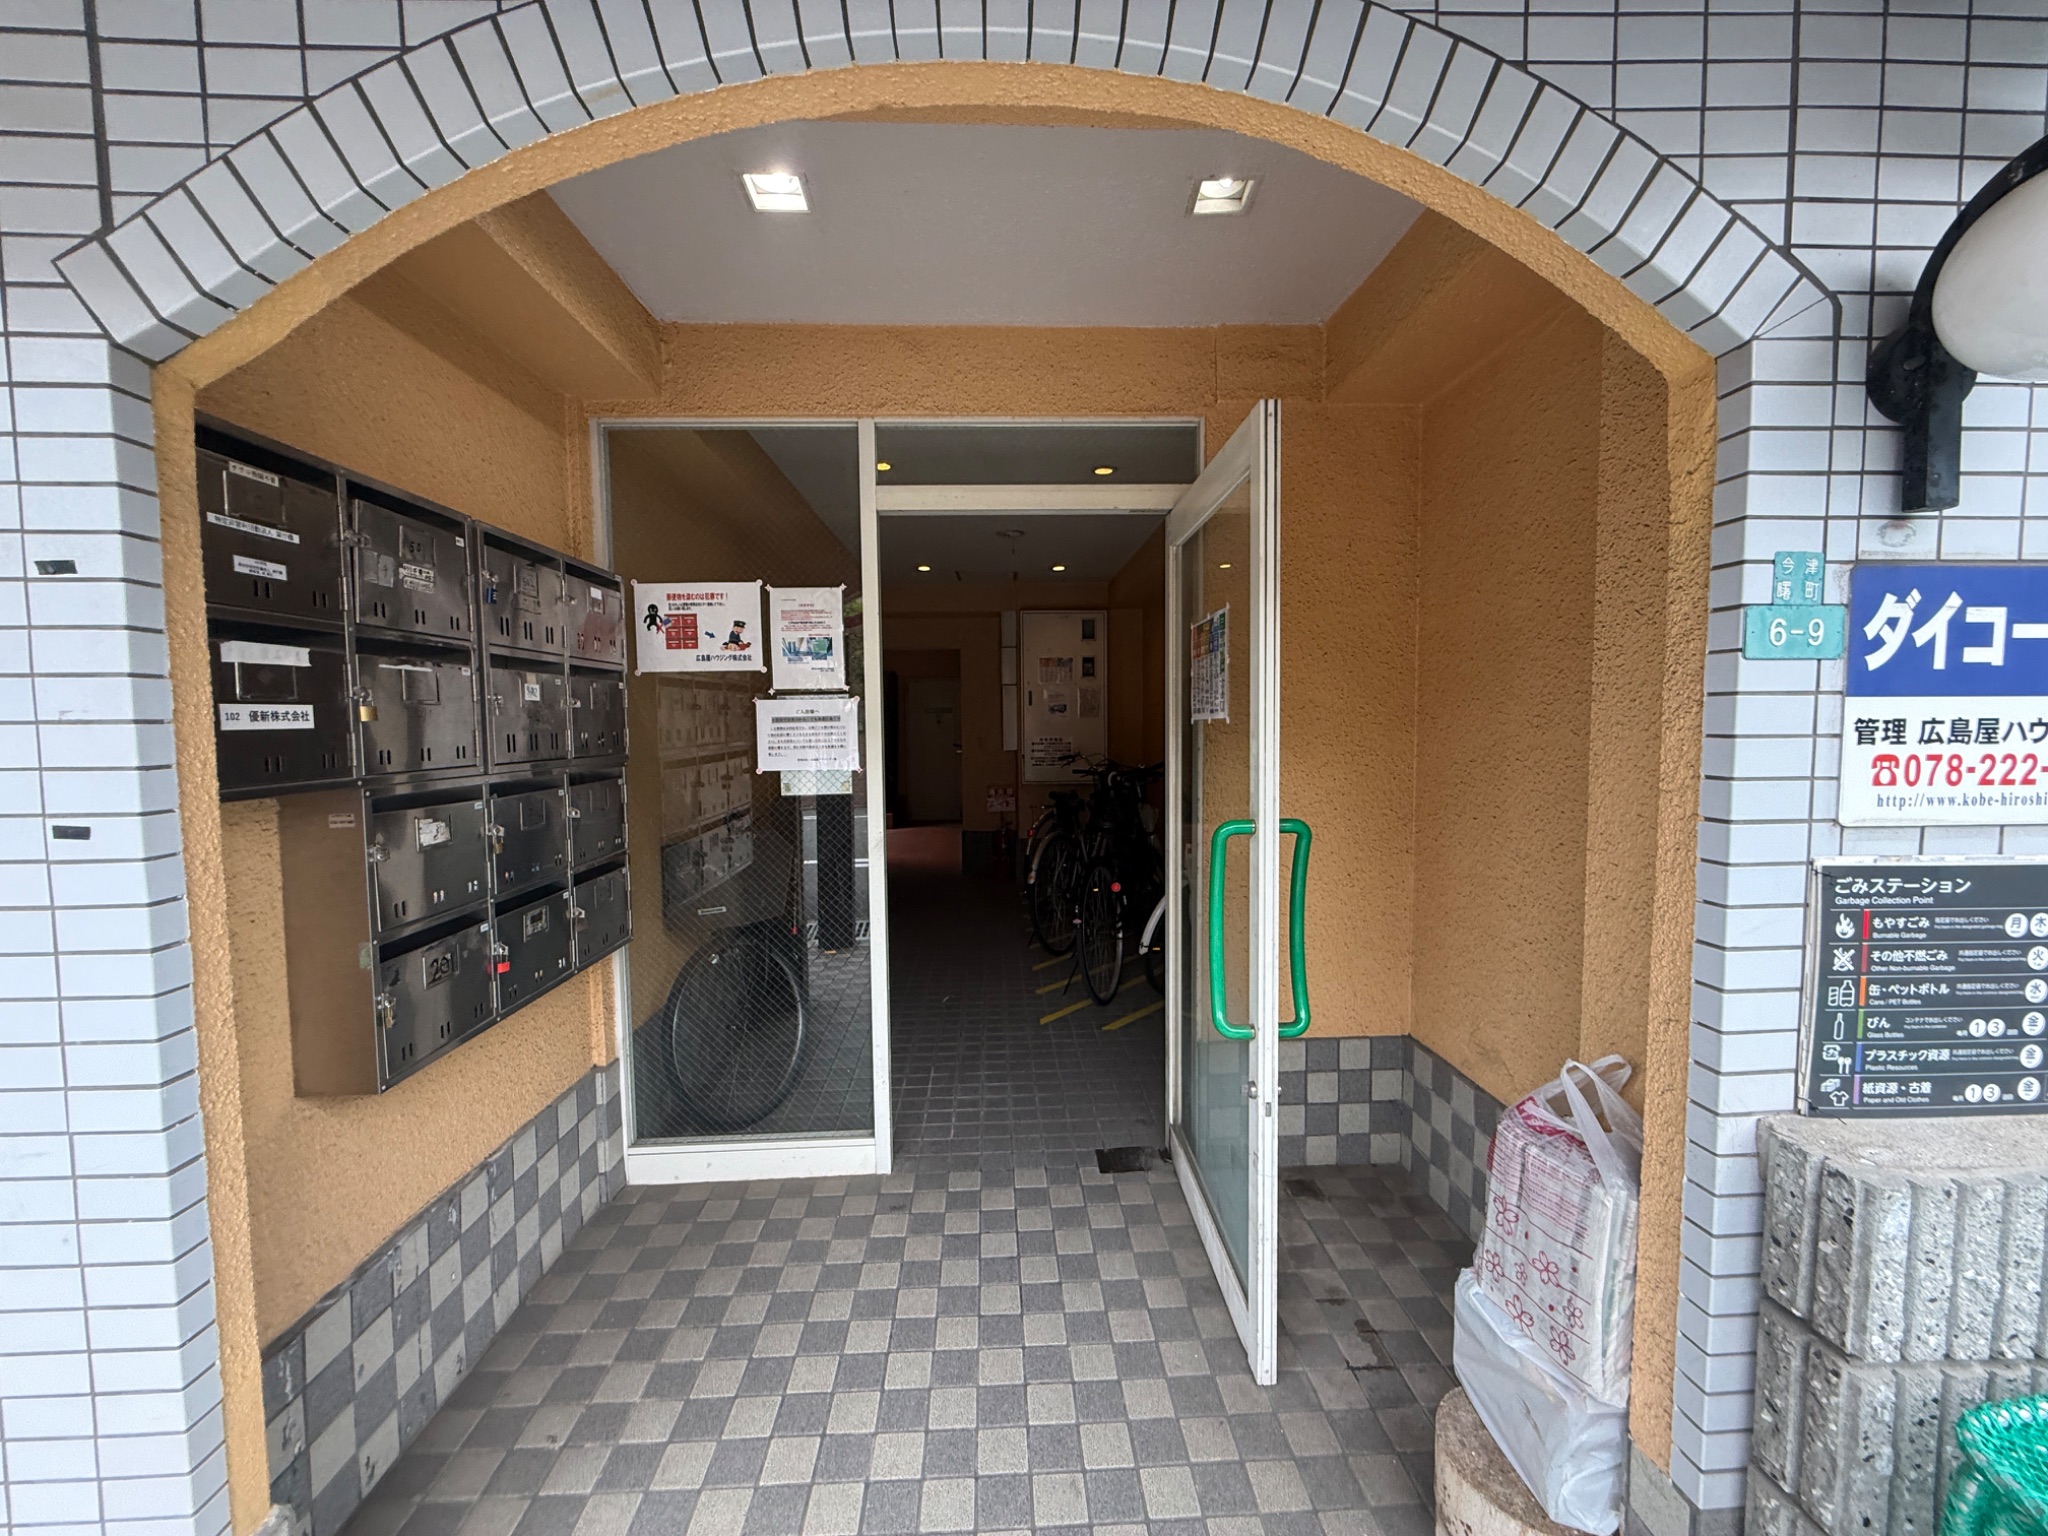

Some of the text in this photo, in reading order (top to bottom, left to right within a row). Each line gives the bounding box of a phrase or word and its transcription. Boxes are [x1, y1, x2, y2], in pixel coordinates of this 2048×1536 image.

[1769, 617, 1825, 647] 6-9
[224, 709, 311, 723] 102 優新株式会社
[1853, 716, 2048, 746] 管理 広島屋ハウ
[1834, 876, 1972, 895] ごみステーション
[1834, 896, 1935, 907] Garbage Collection Point
[1872, 916, 1931, 930] もやすごみ
[2010, 916, 2022, 929] 月
[1872, 931, 1928, 941] Burnable Garbage
[1870, 949, 1949, 963] その他不燃ごみ
[2032, 948, 2045, 962] 火
[429, 953, 456, 983] 201
[1870, 964, 1888, 972] Other
[1929, 964, 1956, 972] Garbage
[1868, 982, 1951, 997] 缶・ペットボトル
[1888, 998, 1902, 1006] PET
[1866, 1016, 1891, 1029] びん
[1864, 1048, 1951, 1062] プラスチック資源
[1862, 1081, 1933, 1095] 紙資源・古着
[1863, 1096, 1883, 1105] Paper
[1882, 1096, 1895, 1104] and
